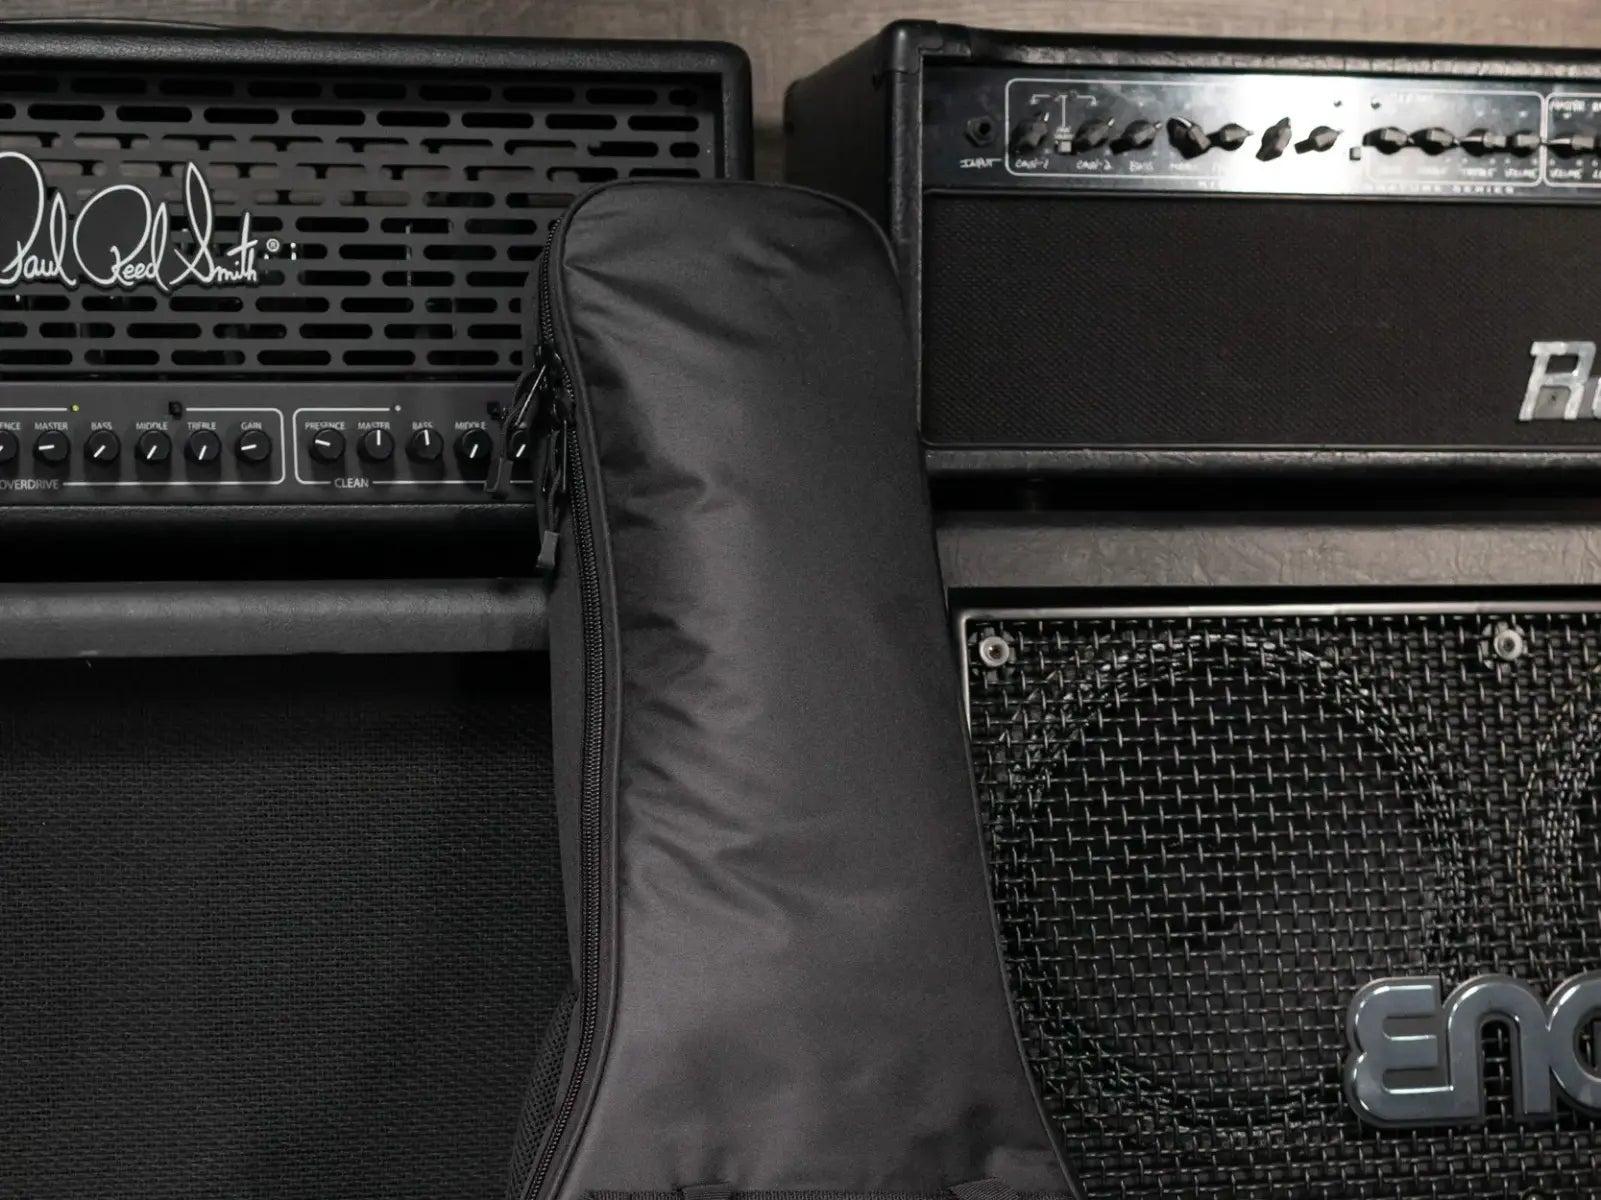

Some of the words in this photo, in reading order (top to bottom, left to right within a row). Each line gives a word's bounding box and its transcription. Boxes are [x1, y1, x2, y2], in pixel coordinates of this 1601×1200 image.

[73, 184, 170, 292] Reed
[169, 161, 258, 286] Smith
[1518, 341, 1601, 420] R
[34, 421, 69, 431] MASTER
[90, 421, 113, 431] BASS
[135, 421, 169, 431] MIDDLE
[187, 421, 217, 431] TREBLE
[240, 421, 263, 431] GAIN
[304, 421, 346, 431] PRESENCE
[357, 421, 391, 431] MASTER
[0, 479, 59, 490] OVERDRIVE
[333, 478, 370, 489] CLEAN
